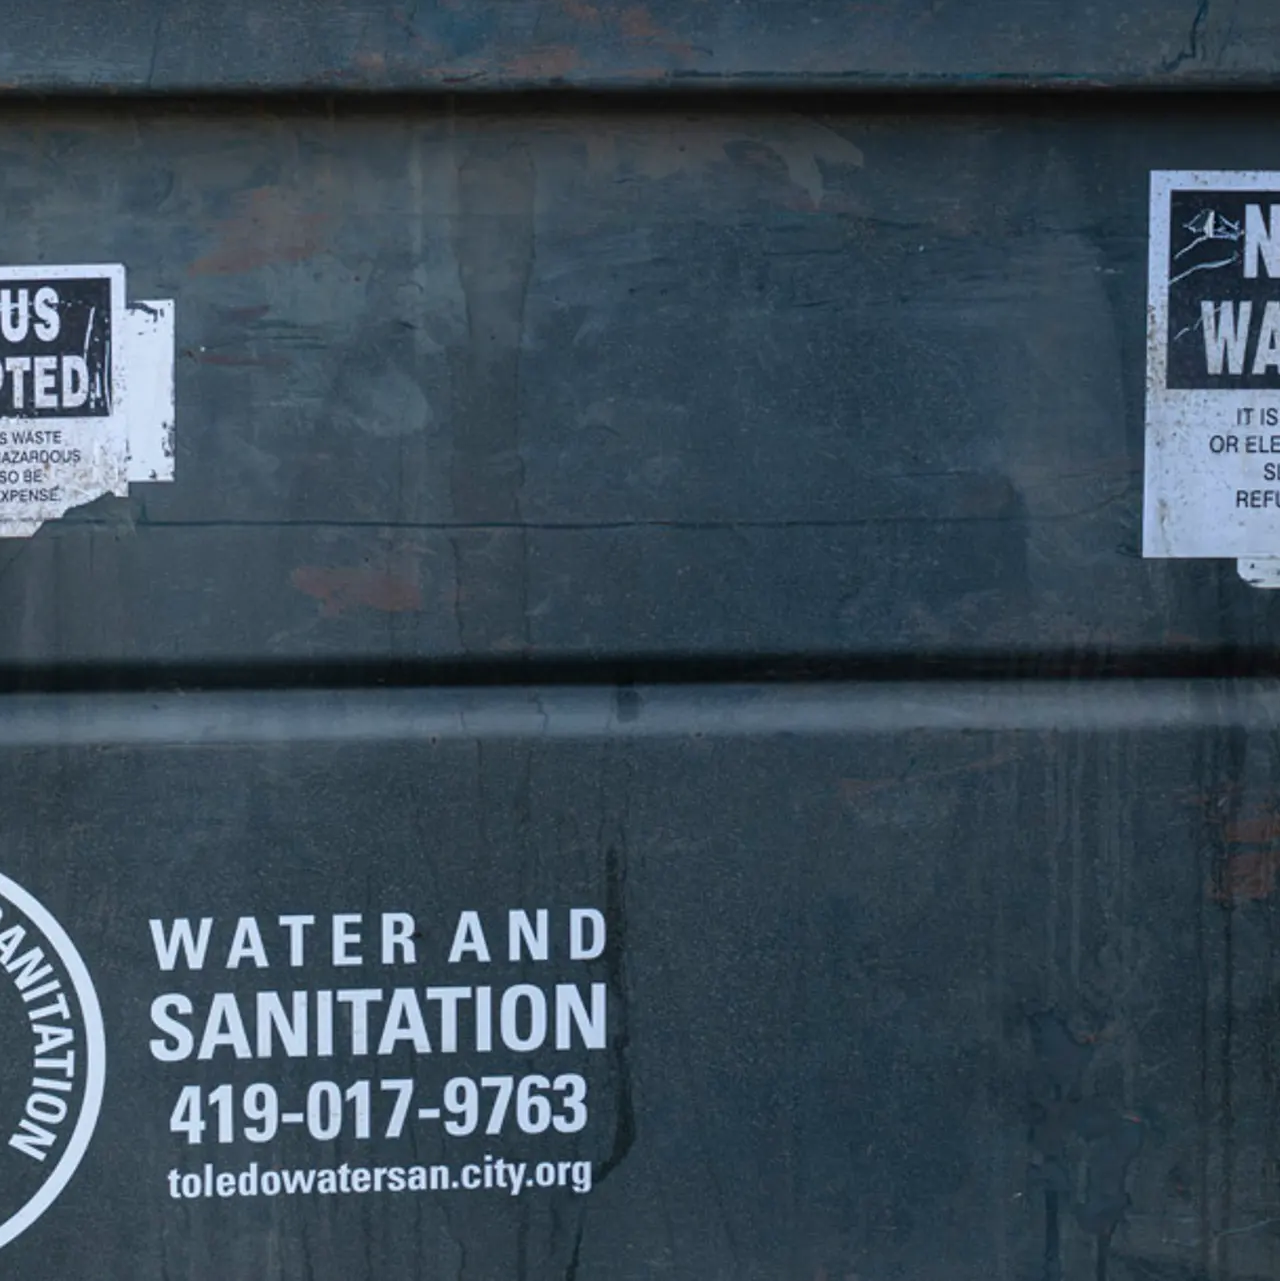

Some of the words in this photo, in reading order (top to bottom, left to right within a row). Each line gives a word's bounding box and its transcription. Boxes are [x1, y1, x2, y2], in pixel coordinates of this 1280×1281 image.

[1237, 408, 1254, 425] IT
[1260, 408, 1278, 426] IS
[11, 430, 62, 445] WASTE
[1209, 435, 1239, 453] OR
[23, 469, 43, 483] BE
[149, 911, 417, 971] WATER
[448, 908, 607, 963] AND
[149, 982, 607, 1062] SANITATION
[169, 1073, 588, 1145] 419-017-9763
[168, 1154, 593, 1199] toledowatersan.city.org
